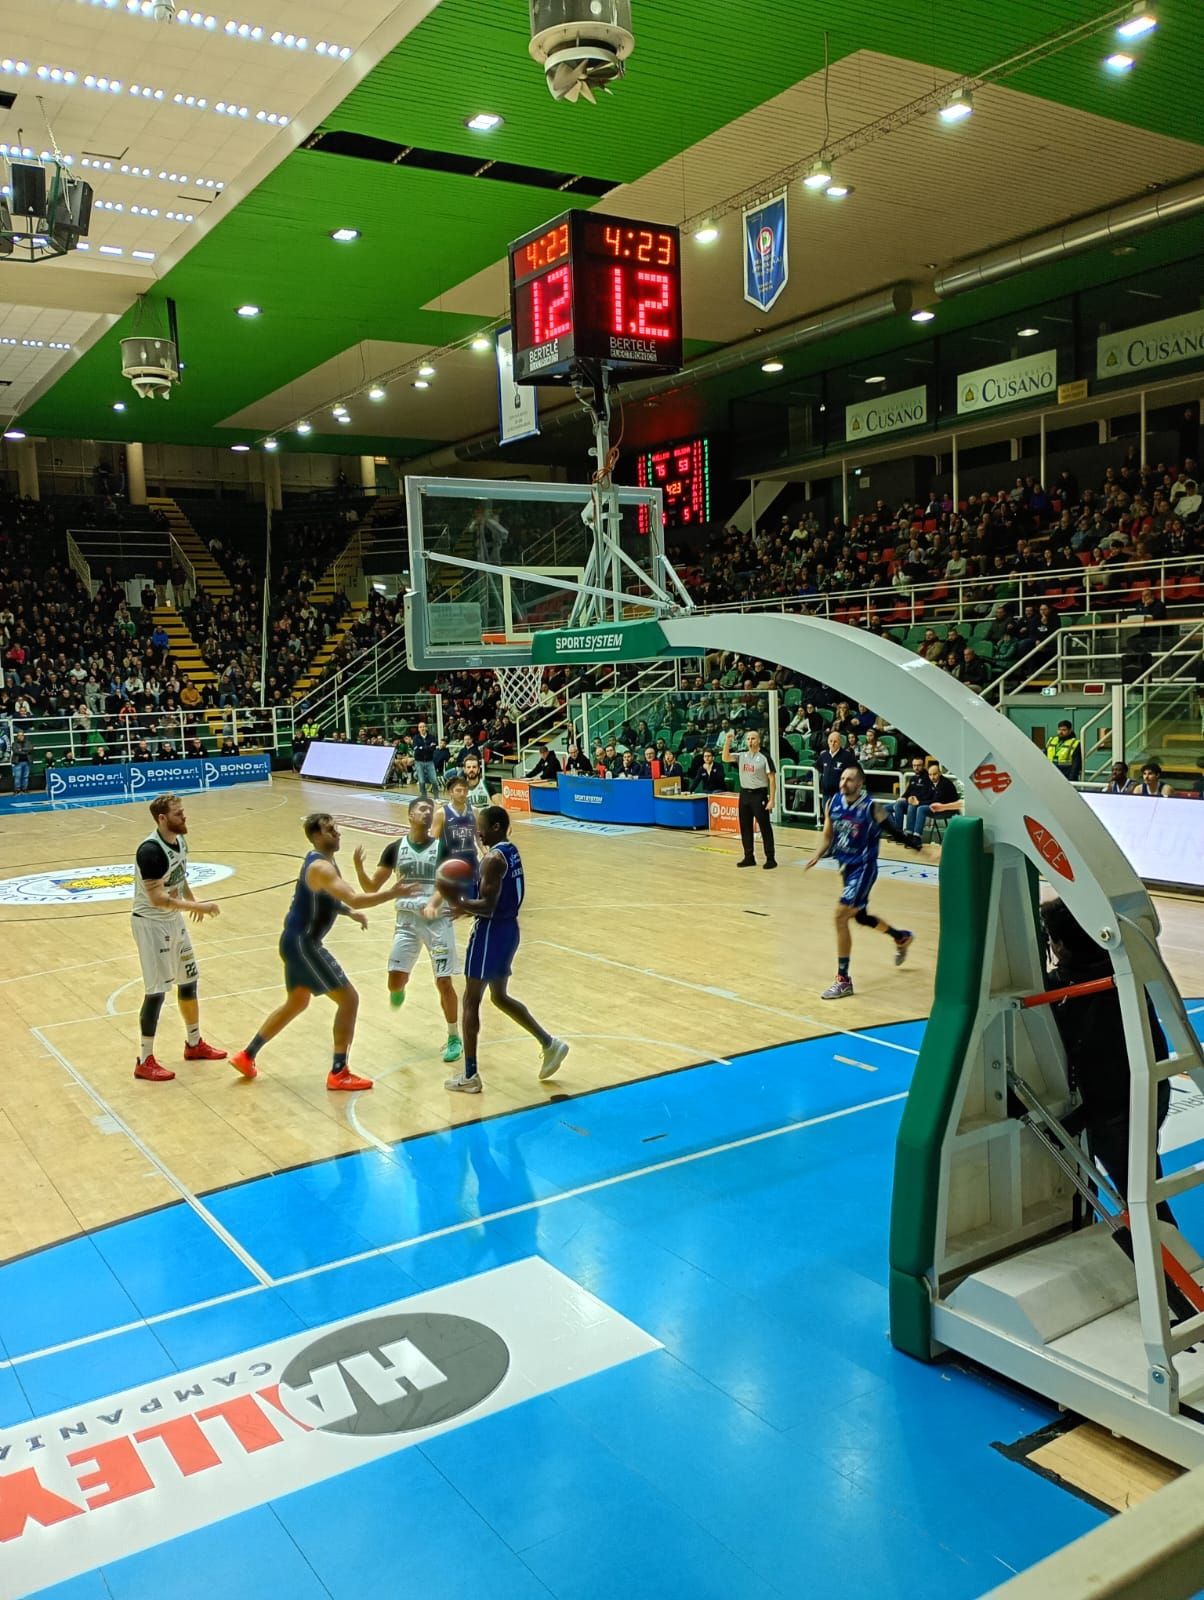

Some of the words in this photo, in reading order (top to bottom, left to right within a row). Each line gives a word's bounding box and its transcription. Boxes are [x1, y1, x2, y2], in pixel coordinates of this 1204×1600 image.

[527, 223, 569, 270] 4:23
[606, 227, 671, 265] 4:23
[982, 371, 1053, 403] CUSANO
[866, 405, 924, 432] CUSANO
[68, 773, 105, 783] BONO
[147, 768, 182, 777] BONO
[220, 763, 252, 772] BONO
[185, 962, 198, 978] 22
